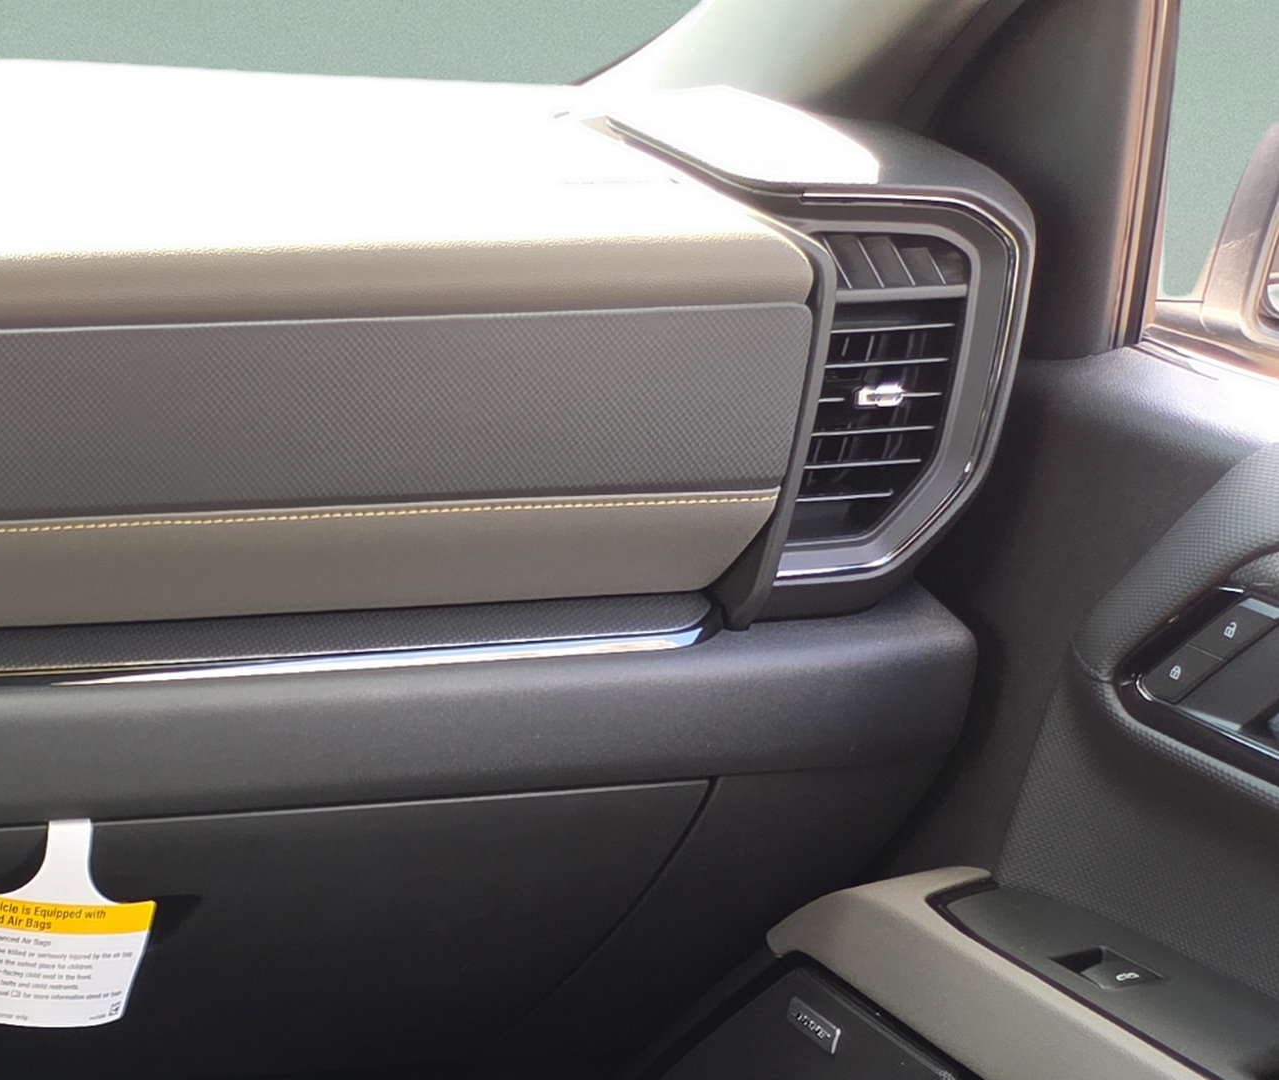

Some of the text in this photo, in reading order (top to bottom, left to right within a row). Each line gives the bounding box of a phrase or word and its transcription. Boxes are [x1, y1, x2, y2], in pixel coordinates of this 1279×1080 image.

[22, 905, 31, 915] is
[34, 906, 83, 920] Equipped
[85, 909, 106, 919] with
[7, 916, 23, 926] Air
[25, 919, 52, 931] Bags
